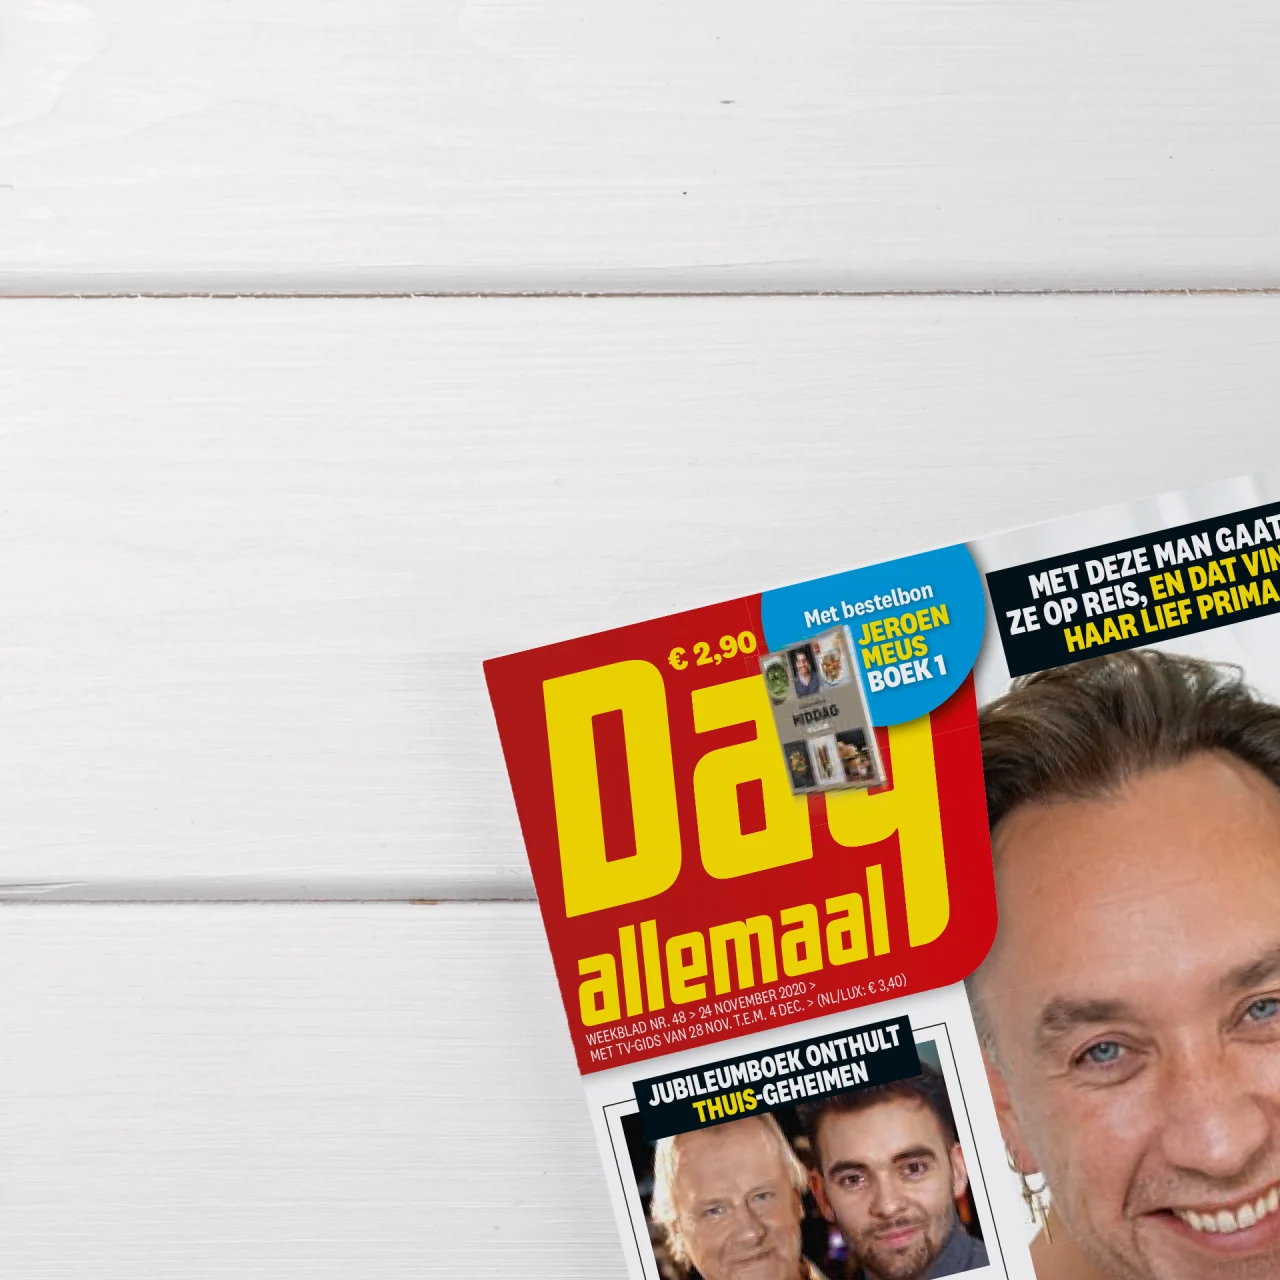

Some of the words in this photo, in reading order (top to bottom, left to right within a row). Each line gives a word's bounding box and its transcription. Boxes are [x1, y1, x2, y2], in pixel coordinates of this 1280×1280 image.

[1005, 605, 1041, 635] ZE
[1043, 597, 1078, 626] OP
[1081, 581, 1148, 617] REIS,
[1149, 569, 1185, 601] EN
[1187, 556, 1237, 591] DAT
[1028, 563, 1079, 599] MET
[1085, 547, 1151, 585] DEZE
[1153, 532, 1213, 569] MAN
[804, 606, 840, 628] Met
[841, 585, 934, 619] bestelbon
[858, 604, 949, 645] JEROEN
[1063, 613, 1139, 653] HAAR
[1140, 598, 1192, 633] LIEF
[1196, 578, 1280, 620] PRIMA
[668, 647, 689, 671] €
[693, 631, 756, 666] 2,90
[861, 635, 928, 669] MEUS
[867, 658, 933, 692] BOEK
[933, 654, 947, 675] 1
[577, 864, 891, 1027] allemaal
[585, 1021, 648, 1046] WEEKBLAD
[649, 1016, 671, 1031] NR.
[672, 1010, 687, 1025] 48
[698, 1004, 712, 1019] 24
[713, 988, 778, 1015] NOVEMBER
[778, 981, 807, 999] 2020
[589, 1045, 613, 1063] MET
[615, 1034, 662, 1055] TV-GIDS
[662, 1027, 687, 1044] VAN
[688, 1023, 704, 1039] 28
[704, 1017, 733, 1034] NOV.
[732, 1009, 767, 1027] T.E.M.
[769, 1005, 777, 1018] 4
[778, 999, 805, 1017] DEC.
[817, 984, 867, 1008] (NL/LUX:
[867, 981, 877, 994] €
[877, 972, 907, 992] 3,40)
[649, 1048, 804, 1107] JUBILEUMBOEK
[805, 1024, 900, 1067] ONTHULT
[692, 1060, 869, 1123] THUIS-GEHEIMEN
